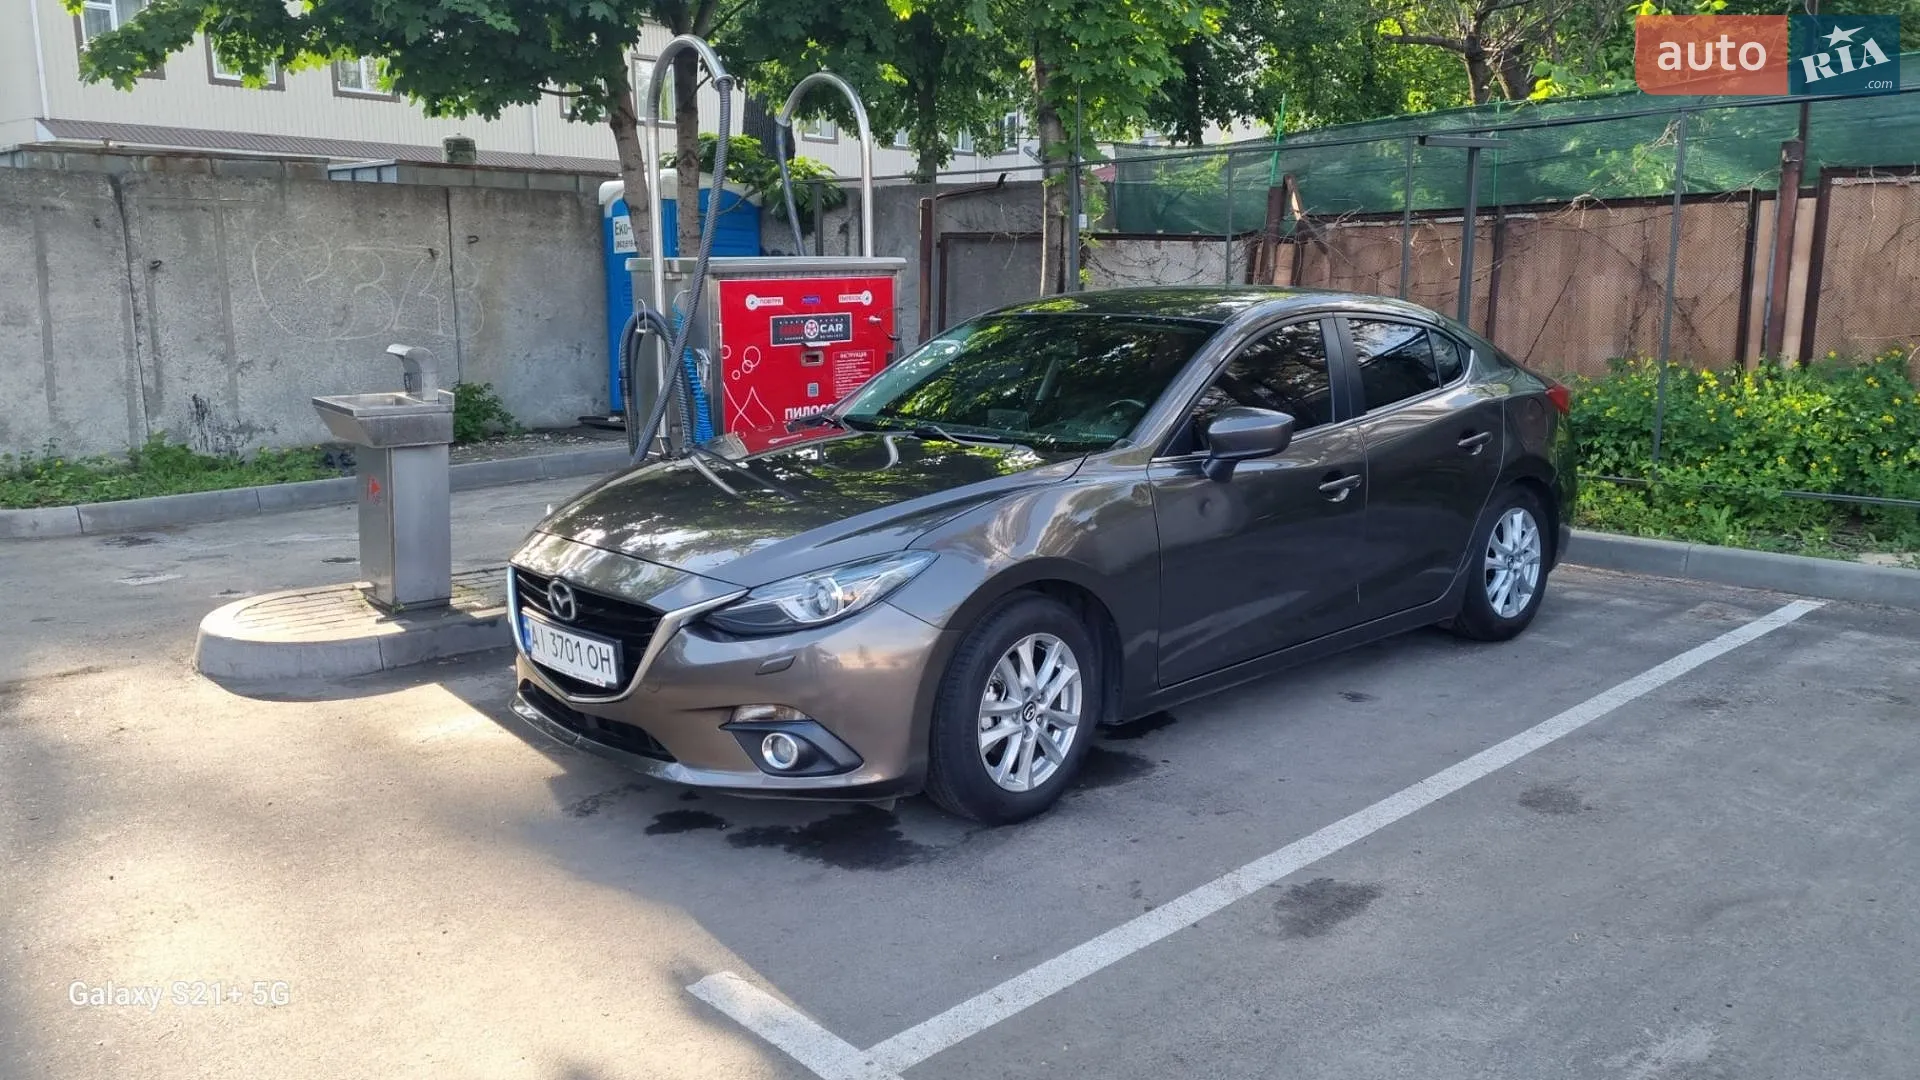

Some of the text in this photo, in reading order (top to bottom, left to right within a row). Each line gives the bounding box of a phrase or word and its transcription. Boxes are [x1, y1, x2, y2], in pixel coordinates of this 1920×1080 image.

[819, 323, 843, 333] CAR
[531, 625, 546, 654] AI
[549, 631, 584, 667] 3701
[586, 645, 612, 675] OH
